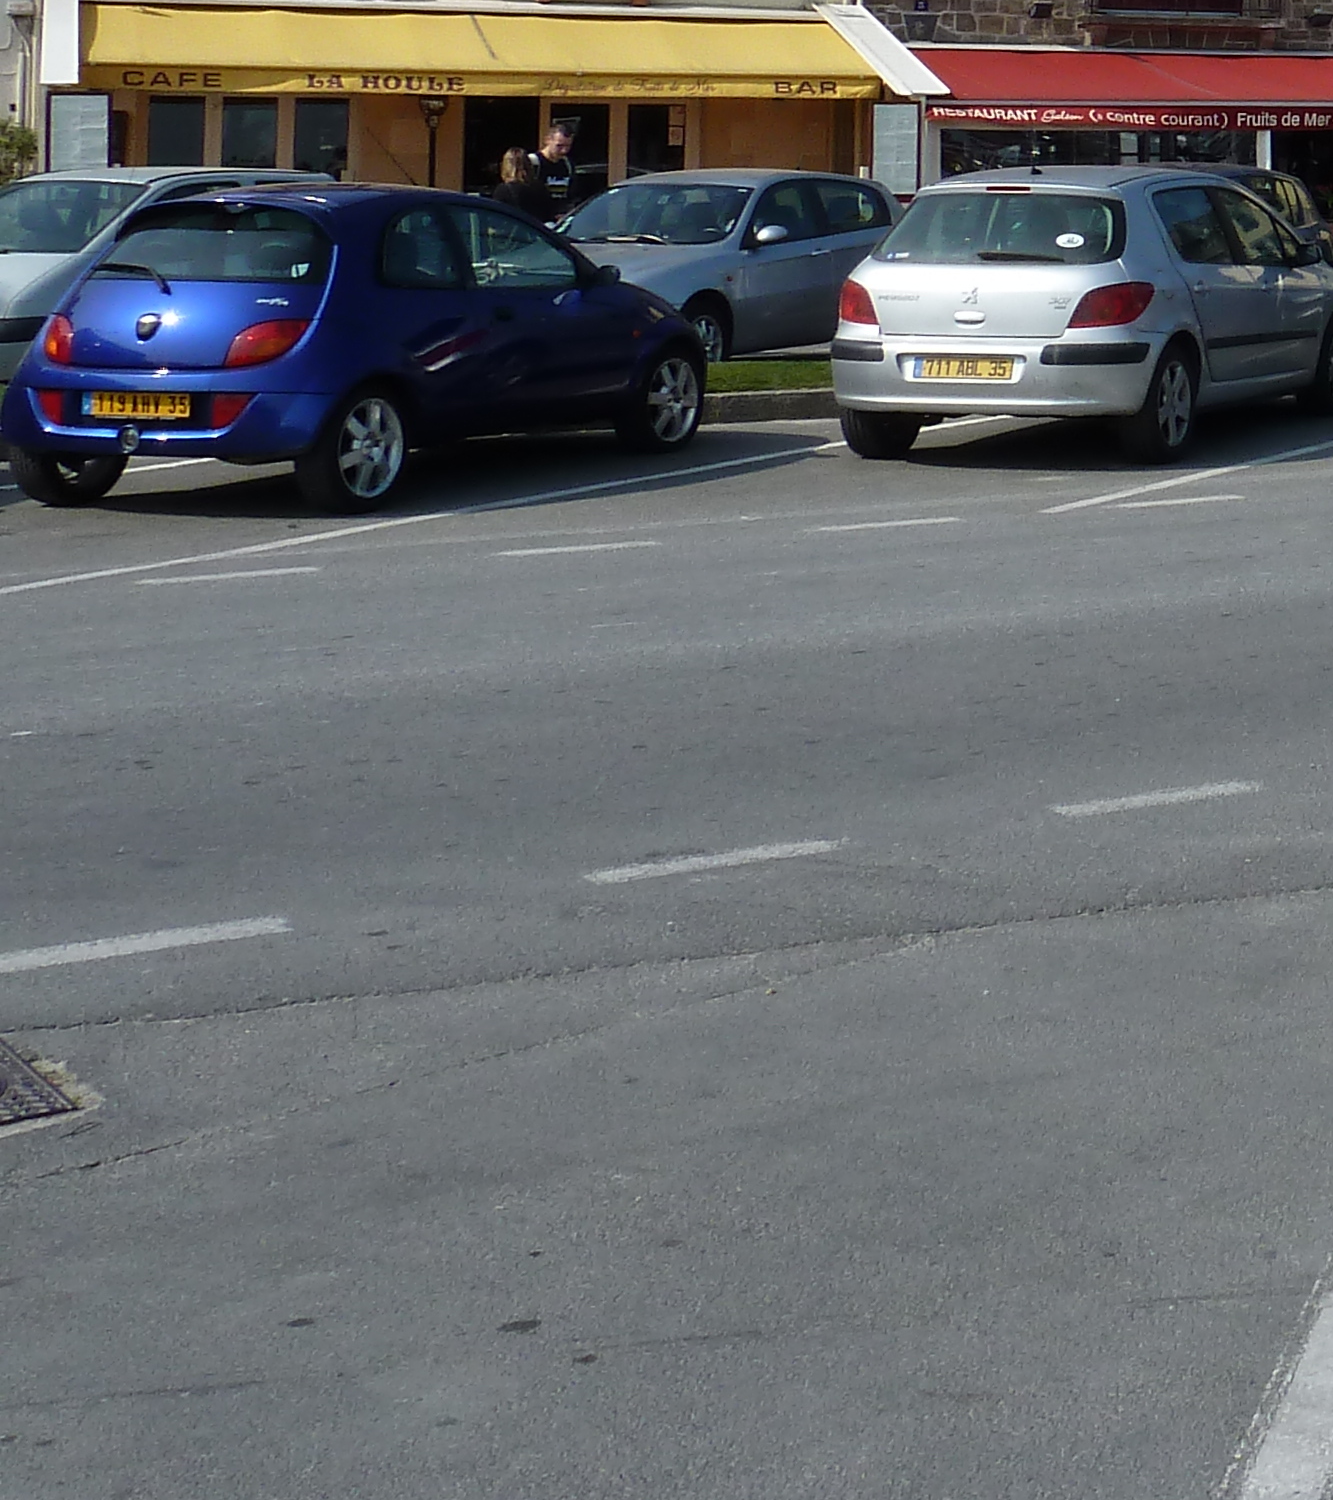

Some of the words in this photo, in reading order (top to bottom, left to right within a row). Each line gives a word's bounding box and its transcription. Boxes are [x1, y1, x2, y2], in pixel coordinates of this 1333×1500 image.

[121, 70, 222, 88] CAFE
[306, 73, 344, 89] LA
[361, 74, 465, 92] HOULE
[774, 81, 838, 95] BAR
[932, 106, 1038, 121] RESTAURANT
[1106, 111, 1155, 125] contre
[1160, 112, 1229, 129] courant)
[1236, 111, 1278, 127] Fruits
[1281, 111, 1300, 127] de
[1304, 112, 1331, 127] Mer
[925, 359, 951, 376] 711
[956, 360, 982, 377] ABL
[988, 360, 1008, 377] 35
[98, 392, 126, 413] 119
[168, 395, 188, 414] 35
